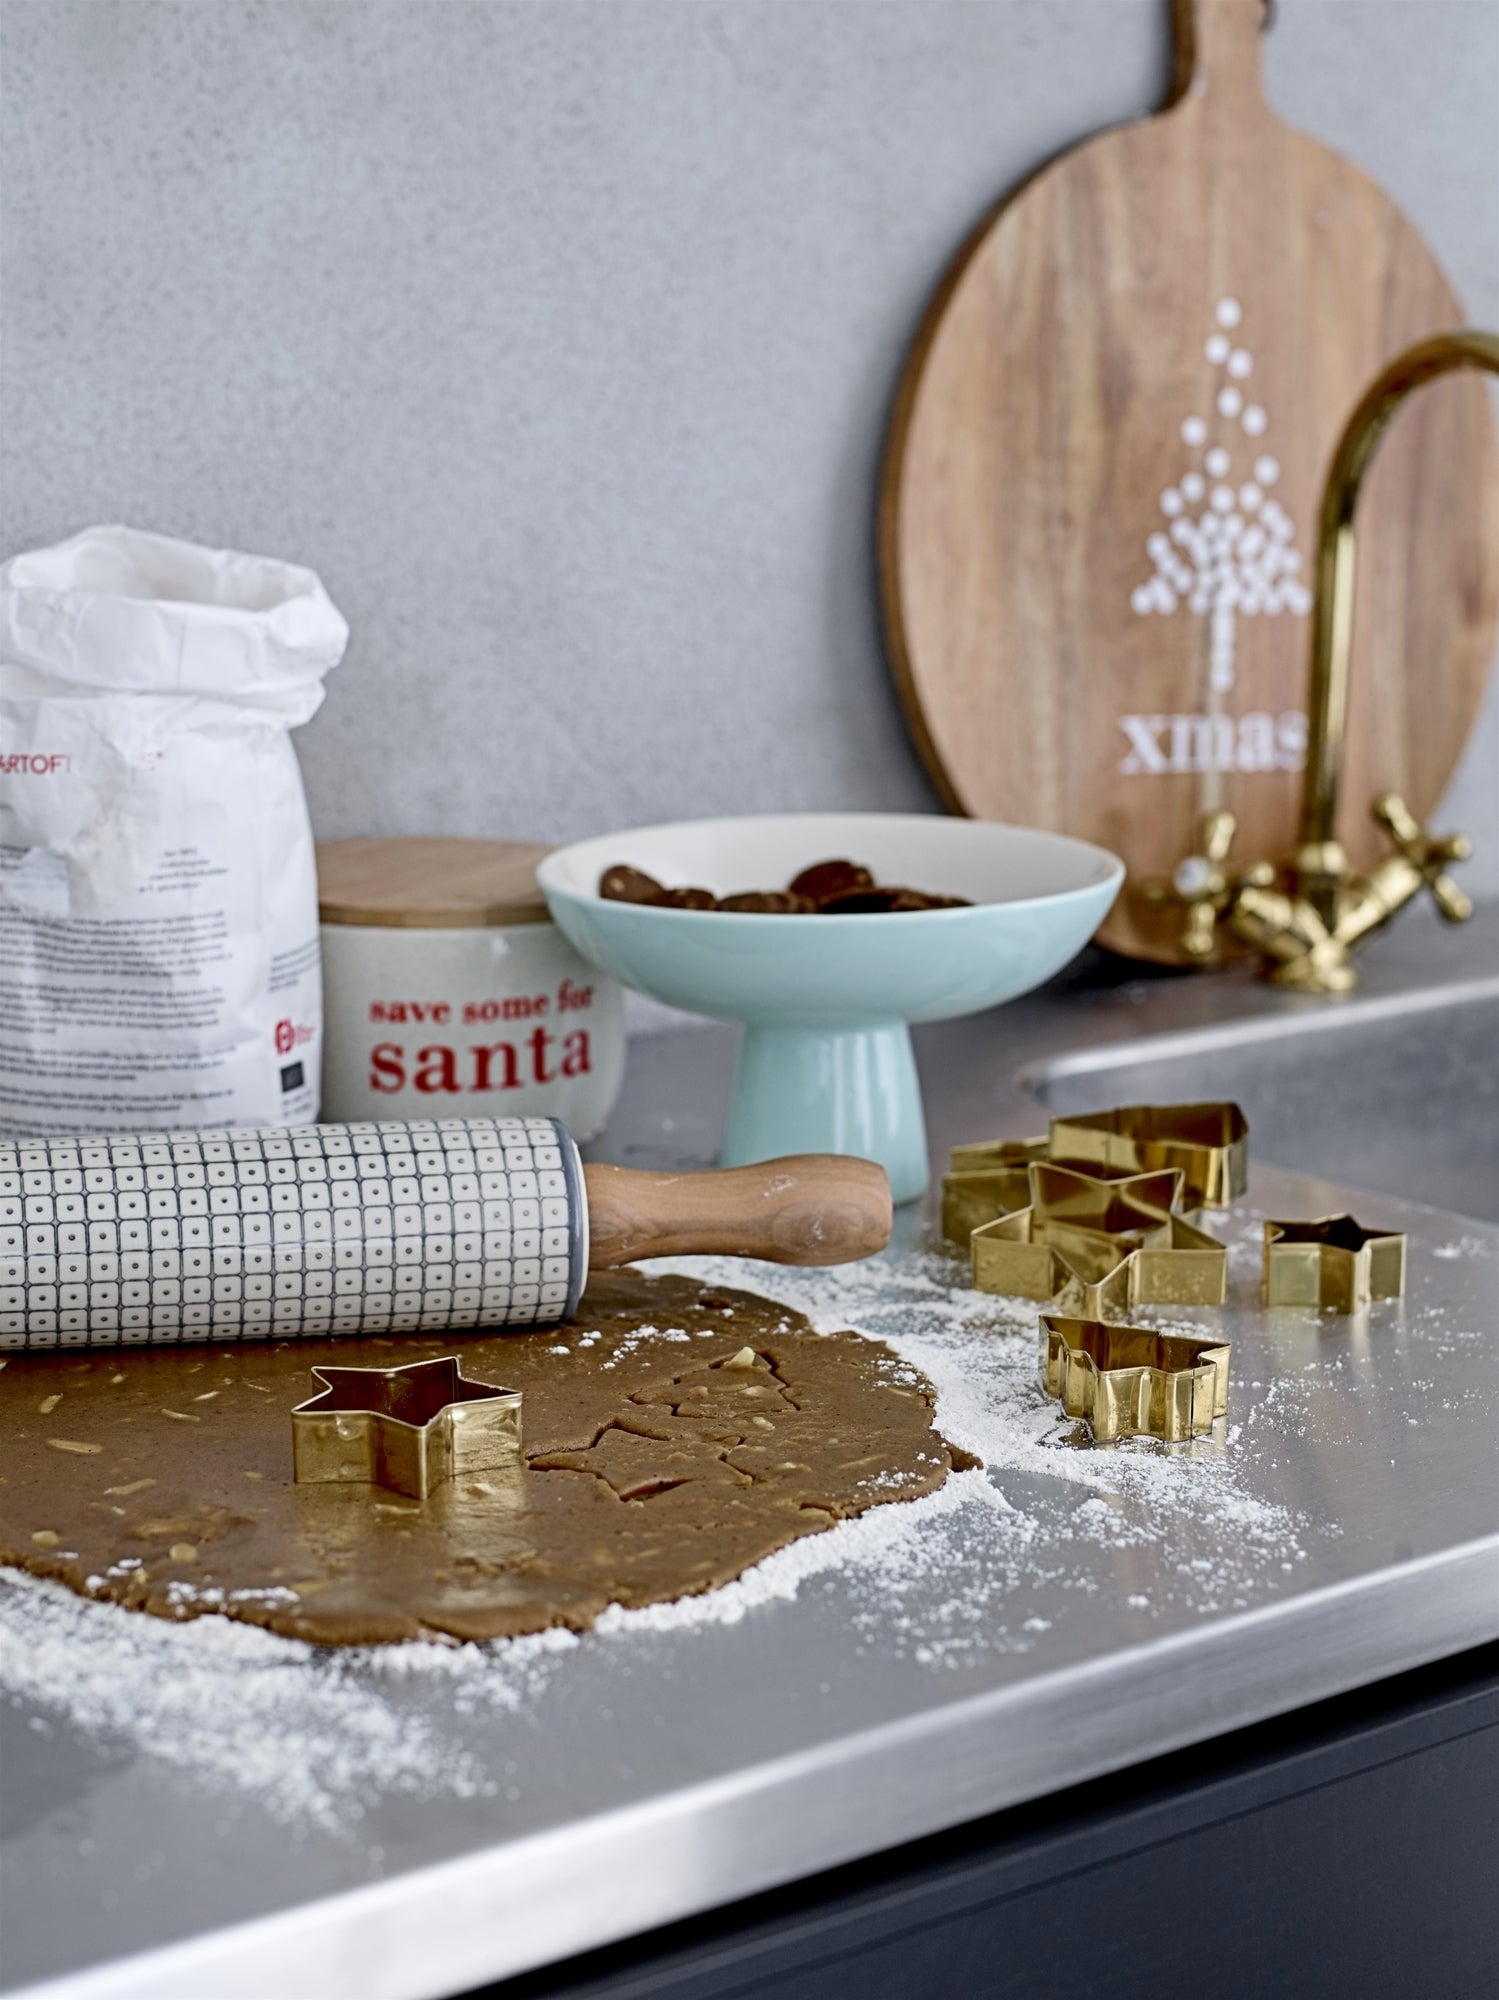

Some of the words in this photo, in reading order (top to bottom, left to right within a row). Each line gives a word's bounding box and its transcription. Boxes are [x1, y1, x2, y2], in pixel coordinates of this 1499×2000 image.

[1118, 710, 1310, 776] xmas
[369, 1000, 451, 1024] save
[462, 993, 549, 1025] some
[557, 977, 595, 1013] for
[368, 1025, 593, 1094] santa
